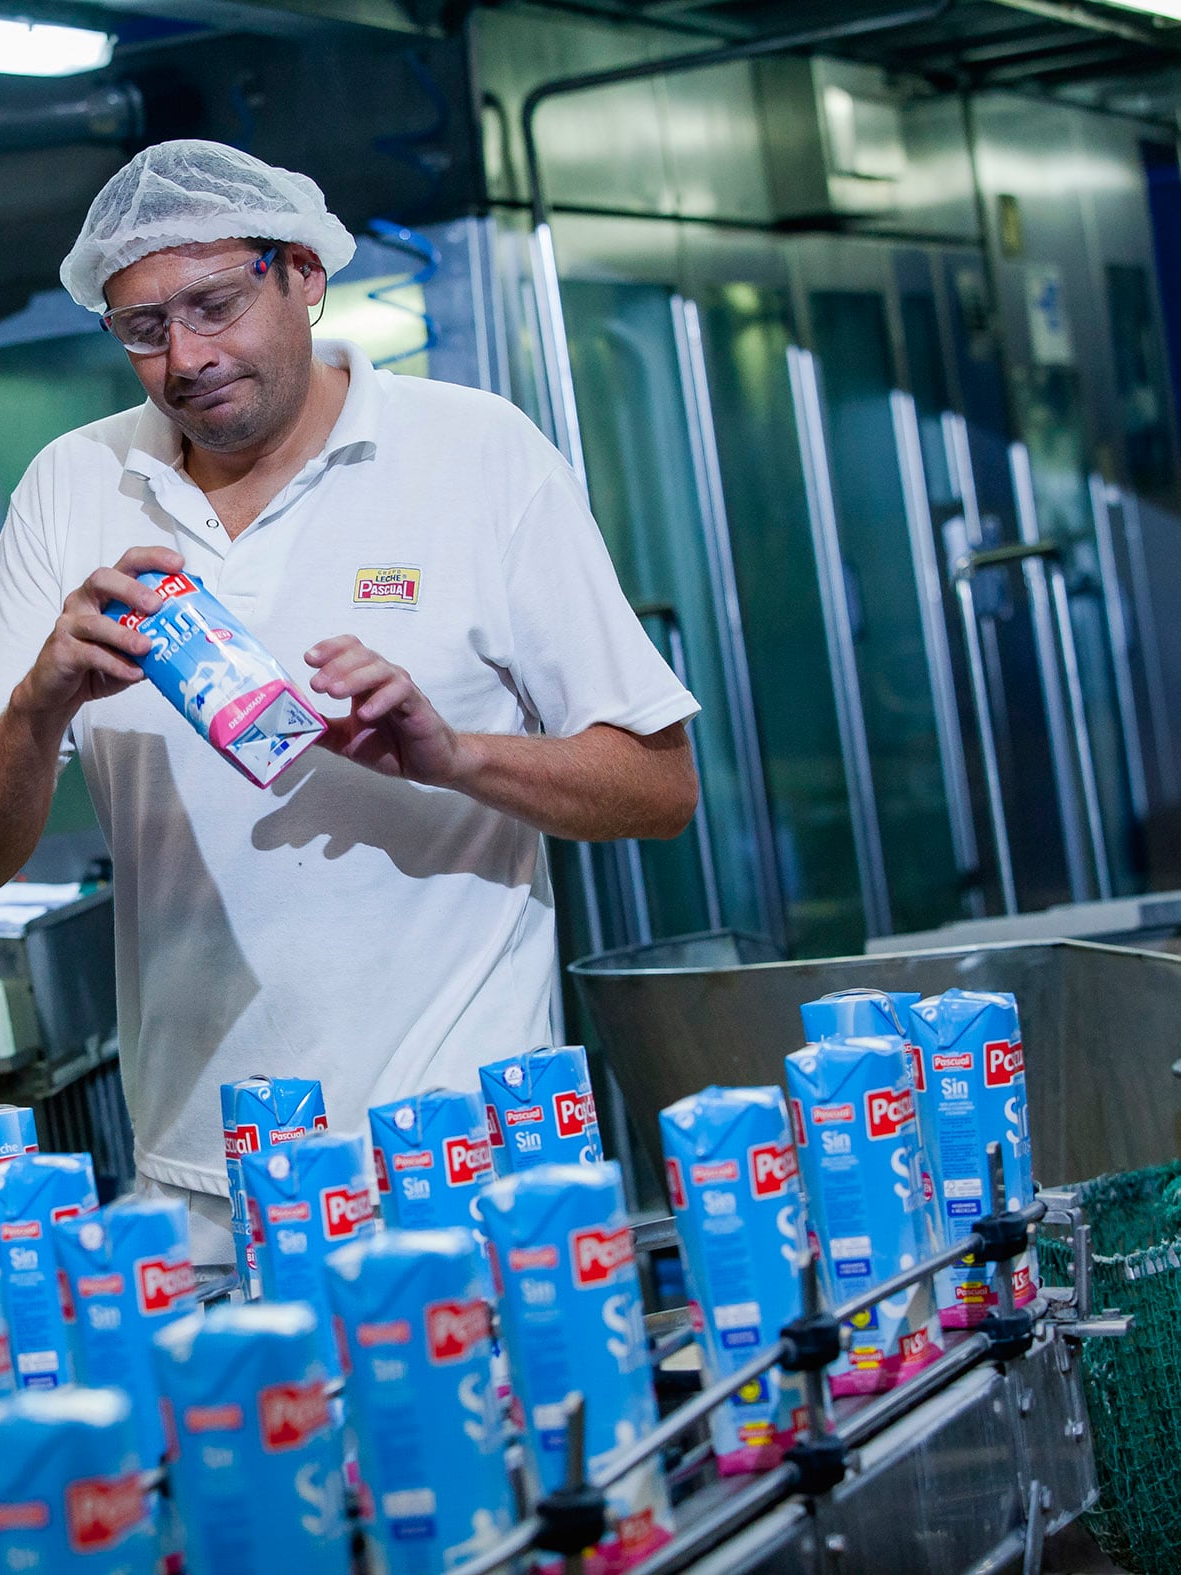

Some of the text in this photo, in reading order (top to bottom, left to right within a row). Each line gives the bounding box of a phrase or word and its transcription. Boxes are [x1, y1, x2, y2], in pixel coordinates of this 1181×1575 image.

[359, 581, 413, 599] PASCUAL
[161, 620, 205, 664] lactos
[228, 693, 267, 730] DESNATADA
[935, 1056, 970, 1066] Pascual
[941, 1078, 968, 1095] Sin
[508, 1110, 541, 1121] Pascual
[561, 1101, 596, 1124] Pascu
[272, 1130, 304, 1141] Pascual
[516, 1131, 541, 1147] Sin
[821, 1130, 851, 1153] Sin
[403, 1177, 430, 1195] Sin
[956, 1287, 989, 1297] Pascual
